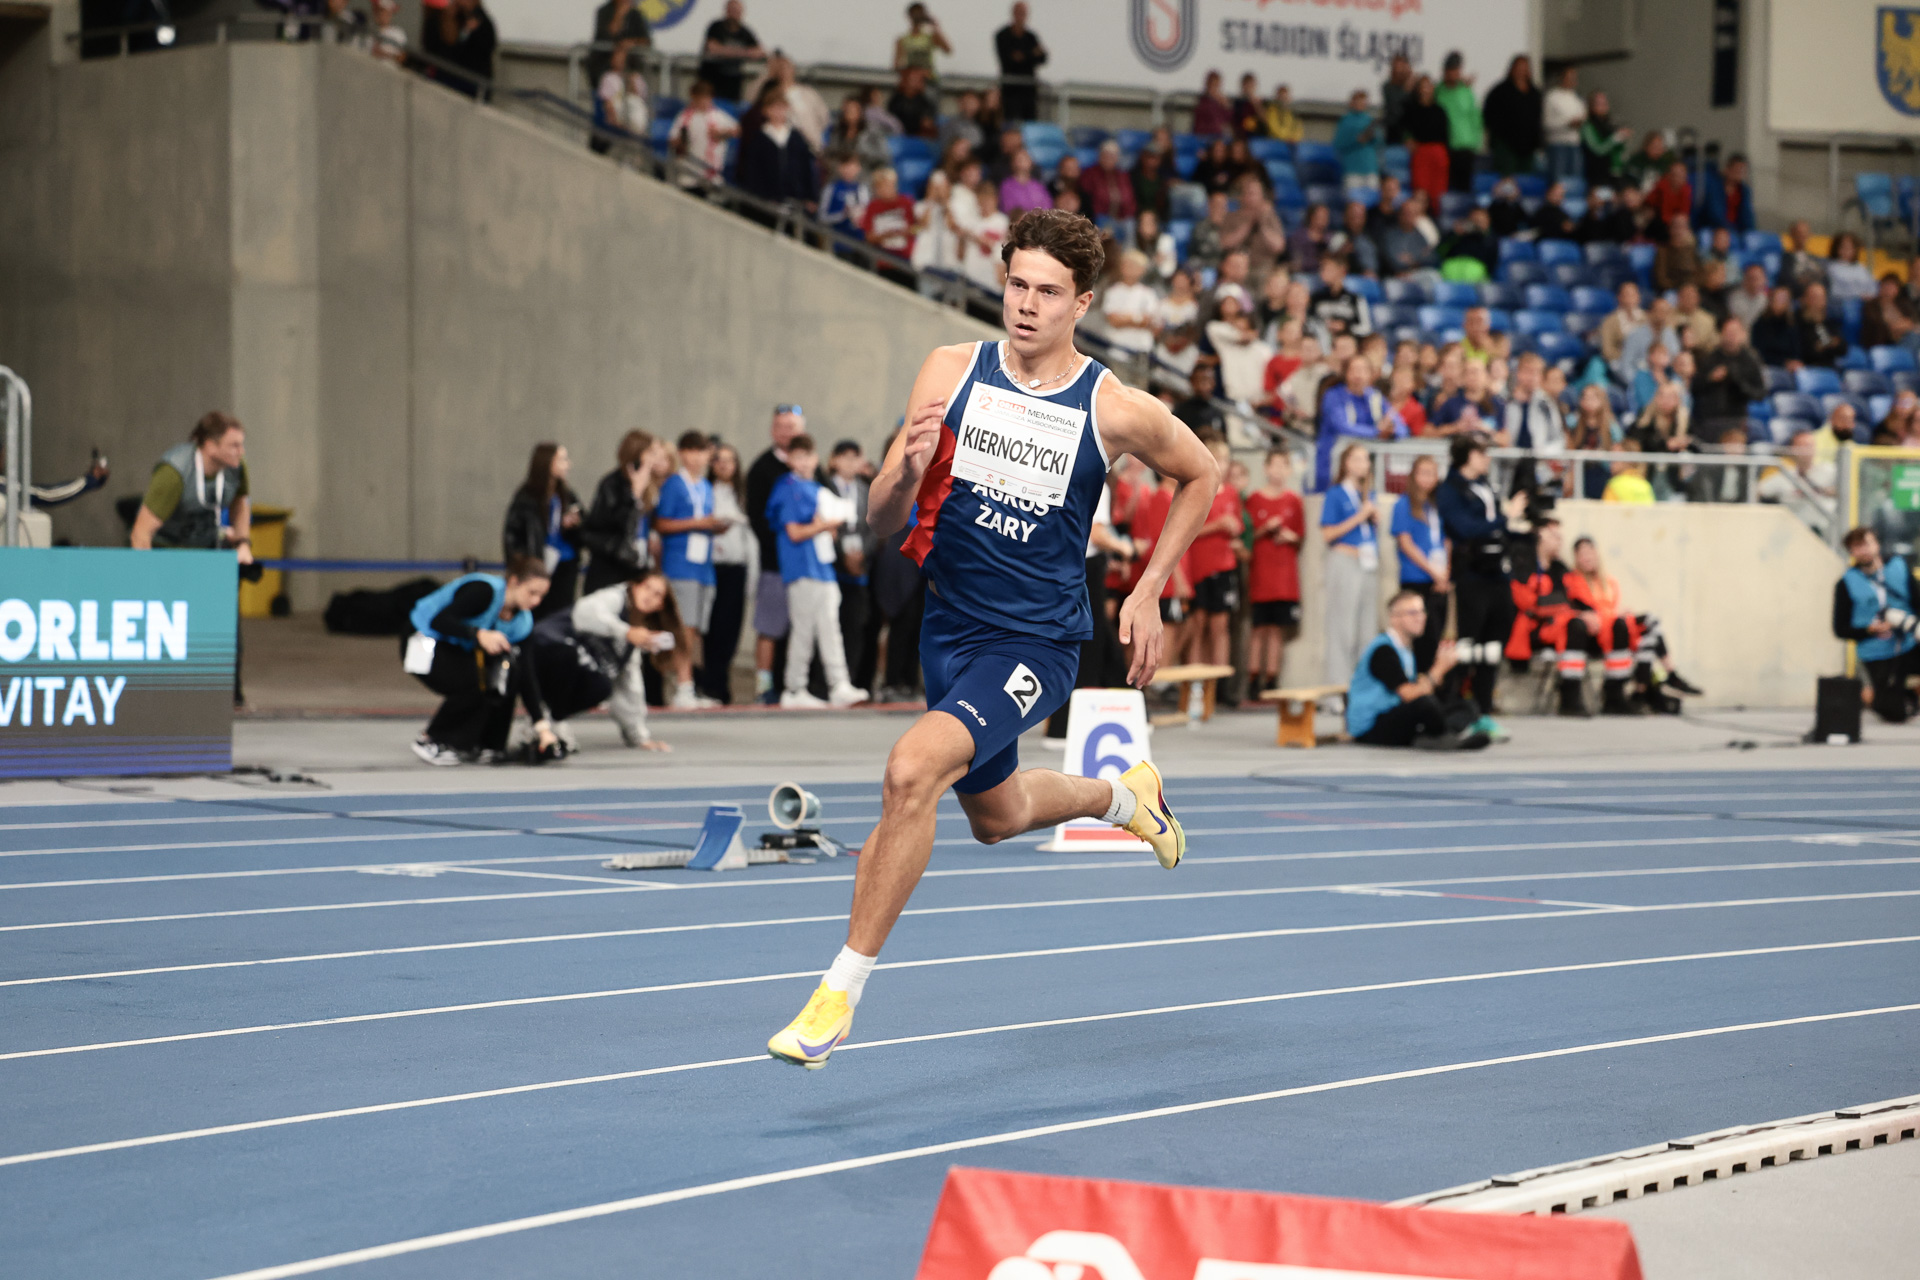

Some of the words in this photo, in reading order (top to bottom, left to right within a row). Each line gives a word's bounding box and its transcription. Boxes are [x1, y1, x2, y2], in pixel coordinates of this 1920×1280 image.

[1222, 18, 1329, 58] STADION
[1027, 409, 1078, 429] MEMORIAŁ
[962, 425, 1069, 475] KIERNOŻYCKI
[974, 501, 1038, 543] ŻARY
[0, 598, 188, 663] ORLEN
[0, 676, 127, 727] VITAY
[1013, 674, 1038, 709] 2
[1083, 722, 1133, 779] 6
